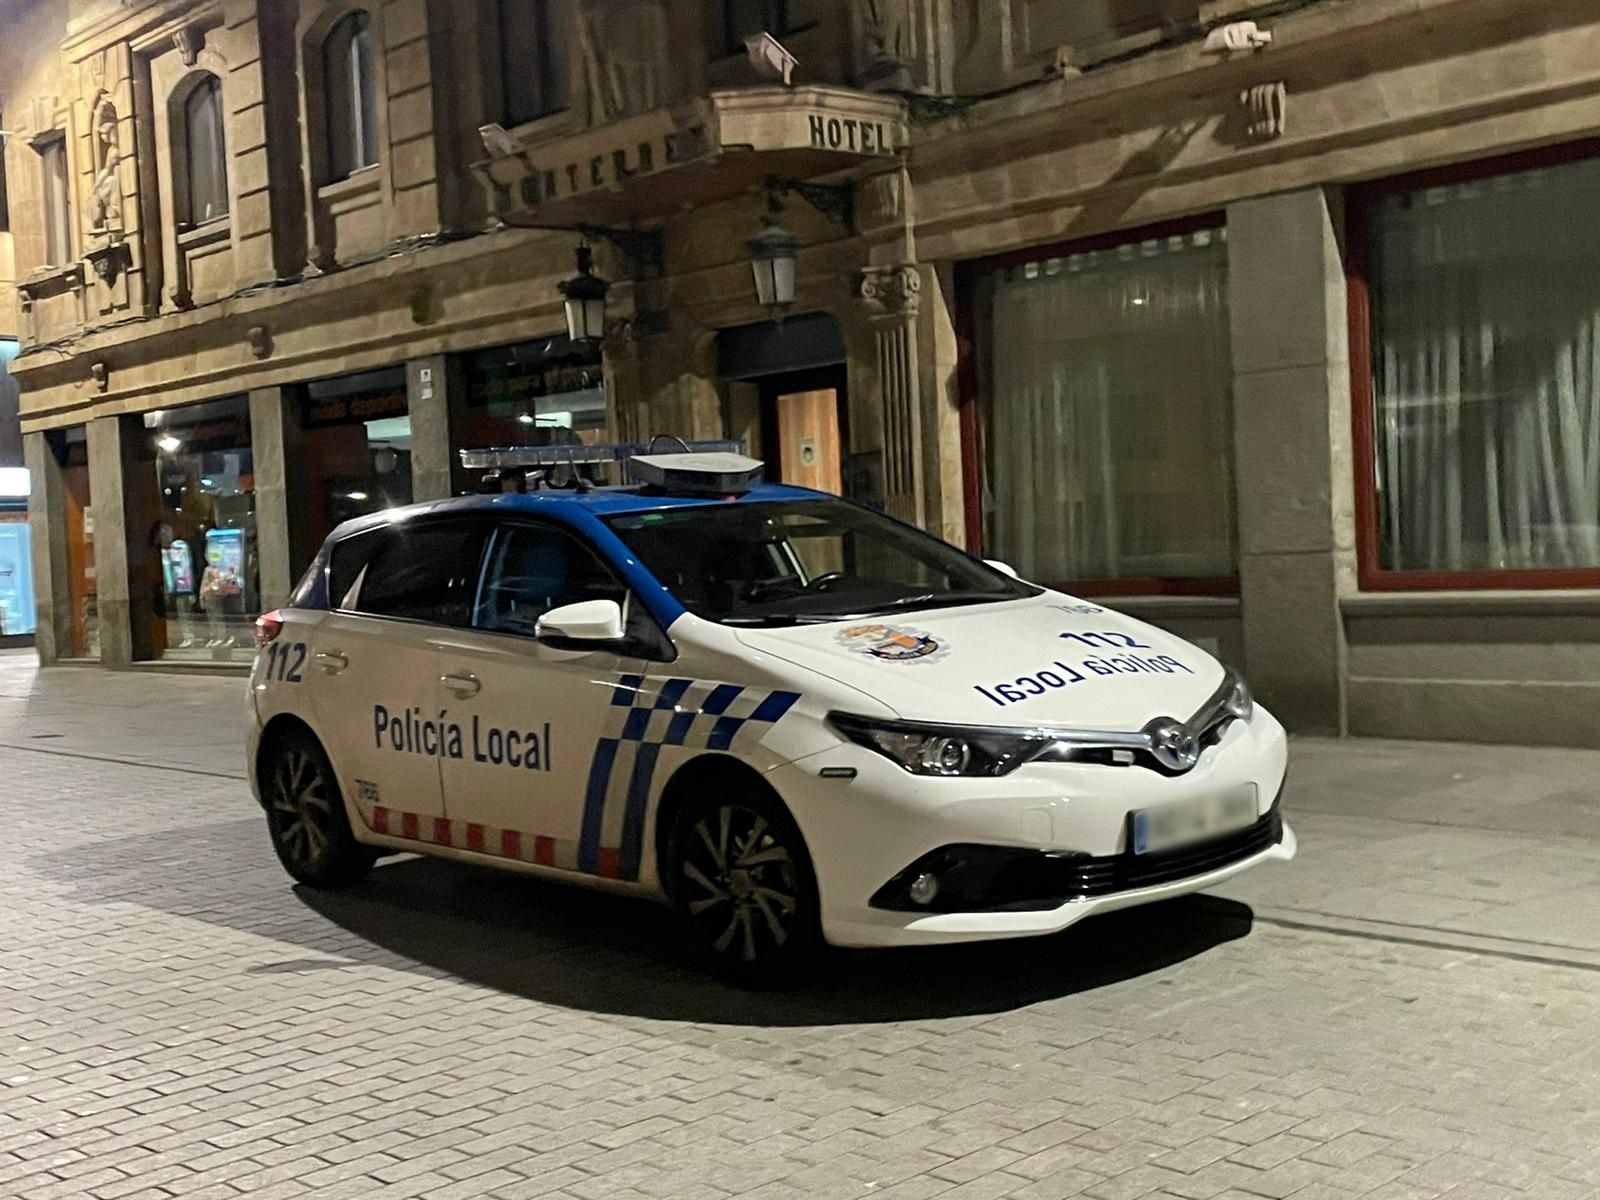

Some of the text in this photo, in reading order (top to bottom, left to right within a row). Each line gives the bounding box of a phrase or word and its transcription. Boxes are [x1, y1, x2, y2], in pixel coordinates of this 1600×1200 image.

[808, 115, 891, 154] HOTEL
[1060, 631, 1151, 650] 112
[266, 641, 307, 684] 112
[374, 702, 552, 773] Policía Local
